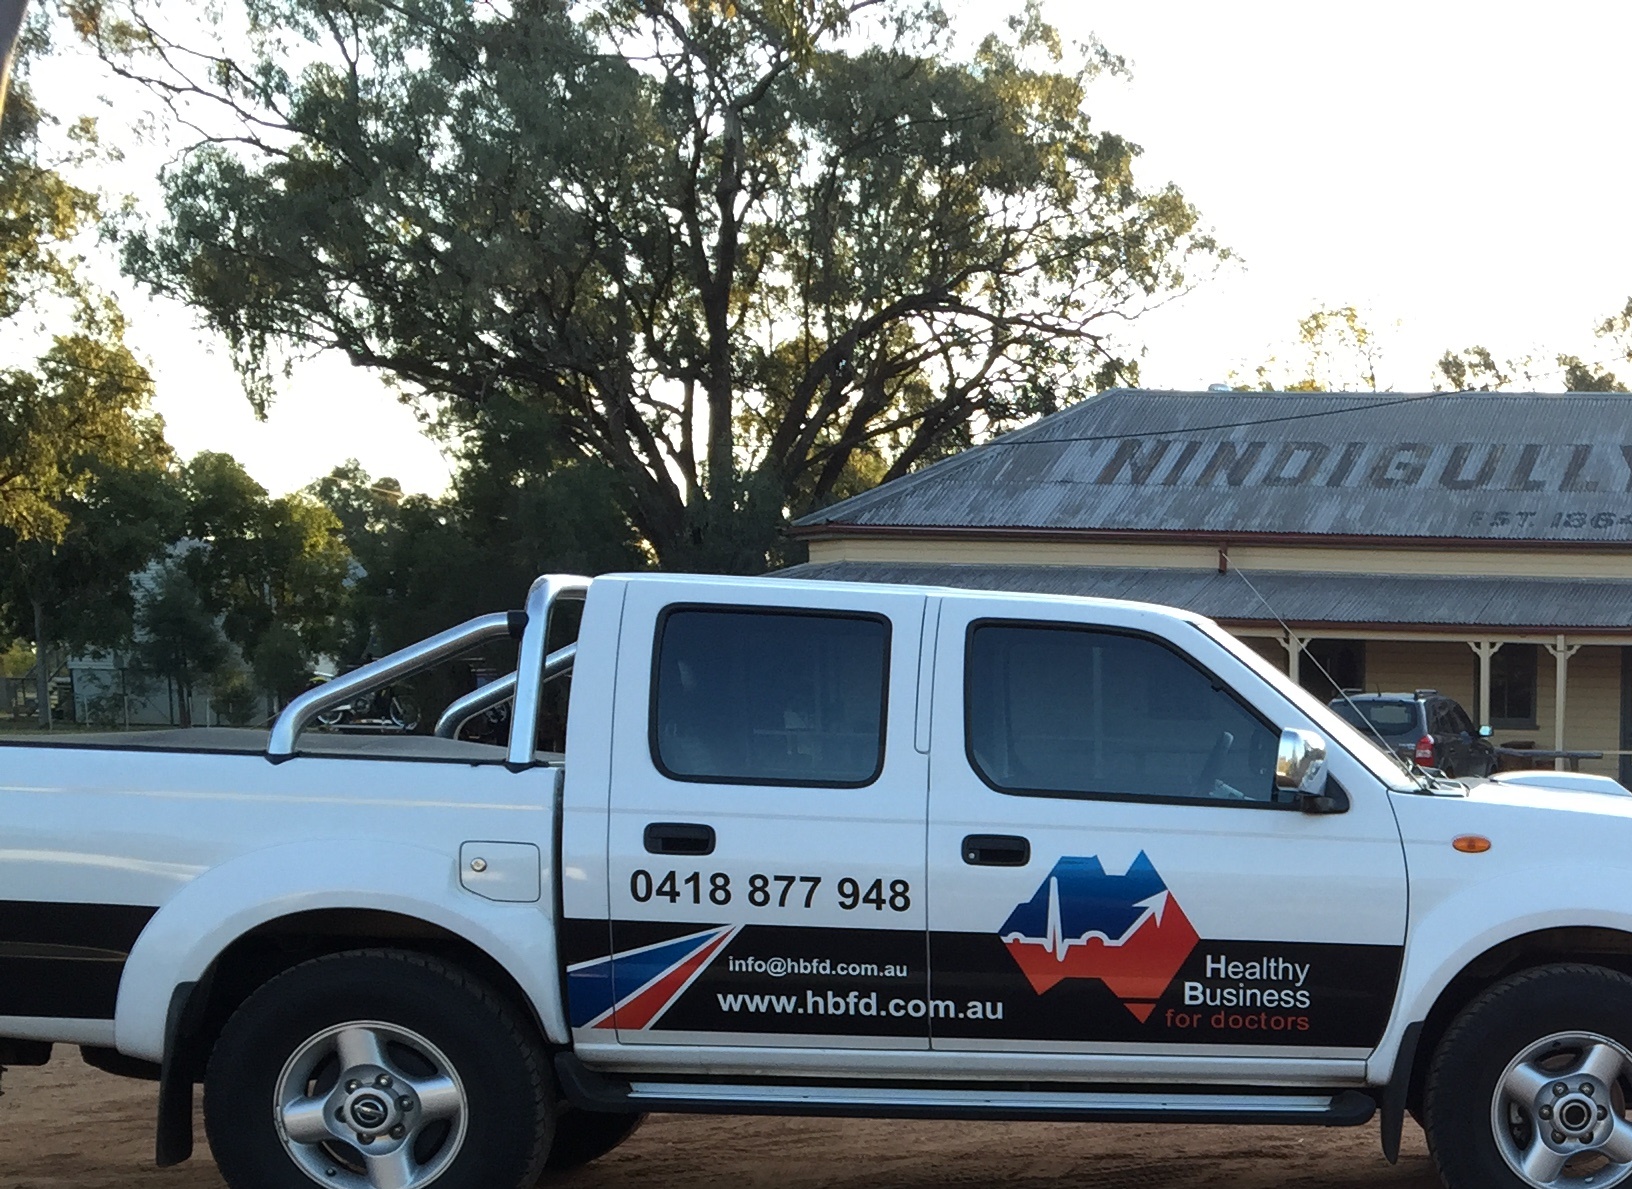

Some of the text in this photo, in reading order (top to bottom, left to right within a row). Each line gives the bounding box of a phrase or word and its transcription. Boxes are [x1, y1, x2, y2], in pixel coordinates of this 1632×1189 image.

[630, 868, 911, 913] 0418 877 948
[728, 955, 908, 978] info@hbfd.com.au
[1205, 953, 1311, 988] Healthy
[716, 989, 1004, 1020] www.hbfd.com.au
[1183, 980, 1311, 1009] Business
[1165, 1008, 1311, 1031] for doctors
